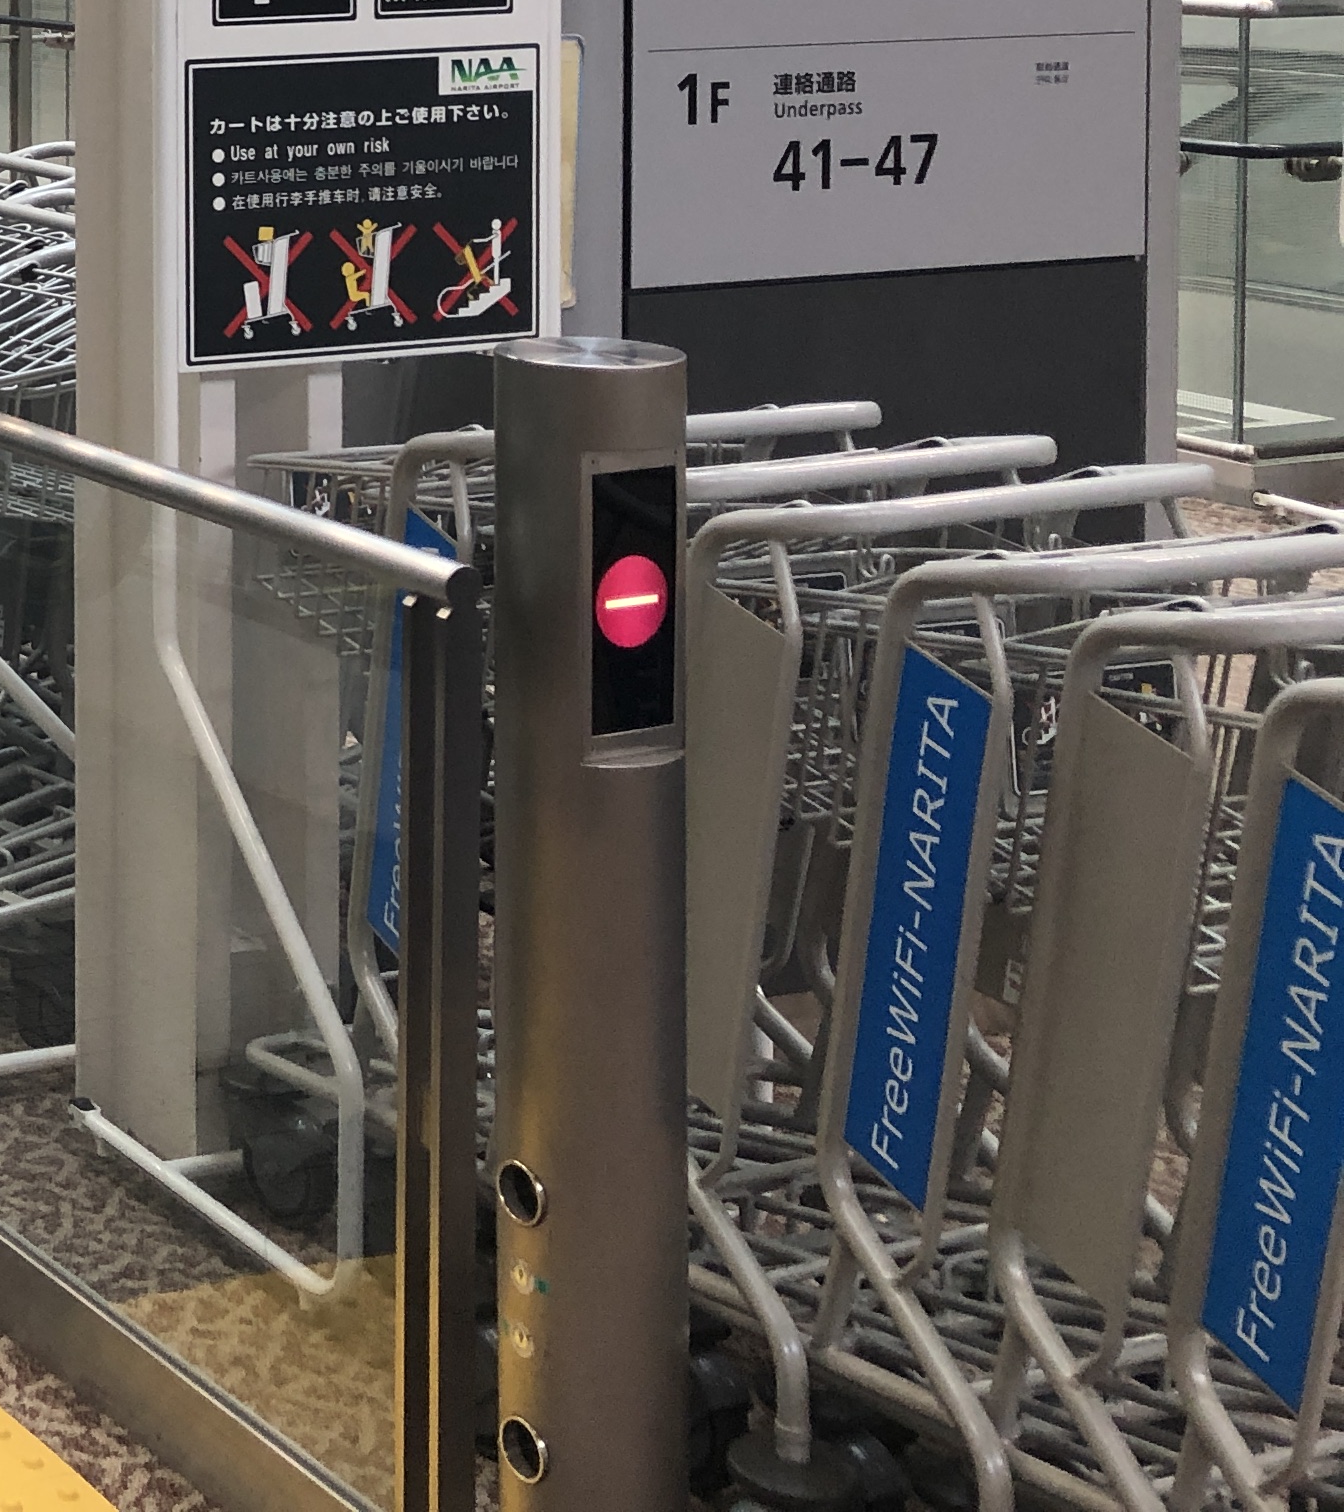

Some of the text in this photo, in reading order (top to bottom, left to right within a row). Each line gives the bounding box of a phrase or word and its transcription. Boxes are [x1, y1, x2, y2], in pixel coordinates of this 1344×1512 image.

[451, 57, 527, 82] NAA
[772, 71, 857, 97] 連絡通路
[676, 72, 730, 126] 1F
[773, 99, 863, 120] Underpass
[209, 103, 509, 135] カートは十分注意の上ご使用下さい。
[231, 137, 390, 161] Use at your own risk
[773, 133, 938, 191] 41-47
[231, 168, 308, 185] 카트사용에는
[358, 161, 396, 178] 주의를
[402, 157, 464, 175] 기울이시기
[469, 154, 519, 170] 바랍니다
[872, 693, 960, 1173] FreeWiFi-NARITA
